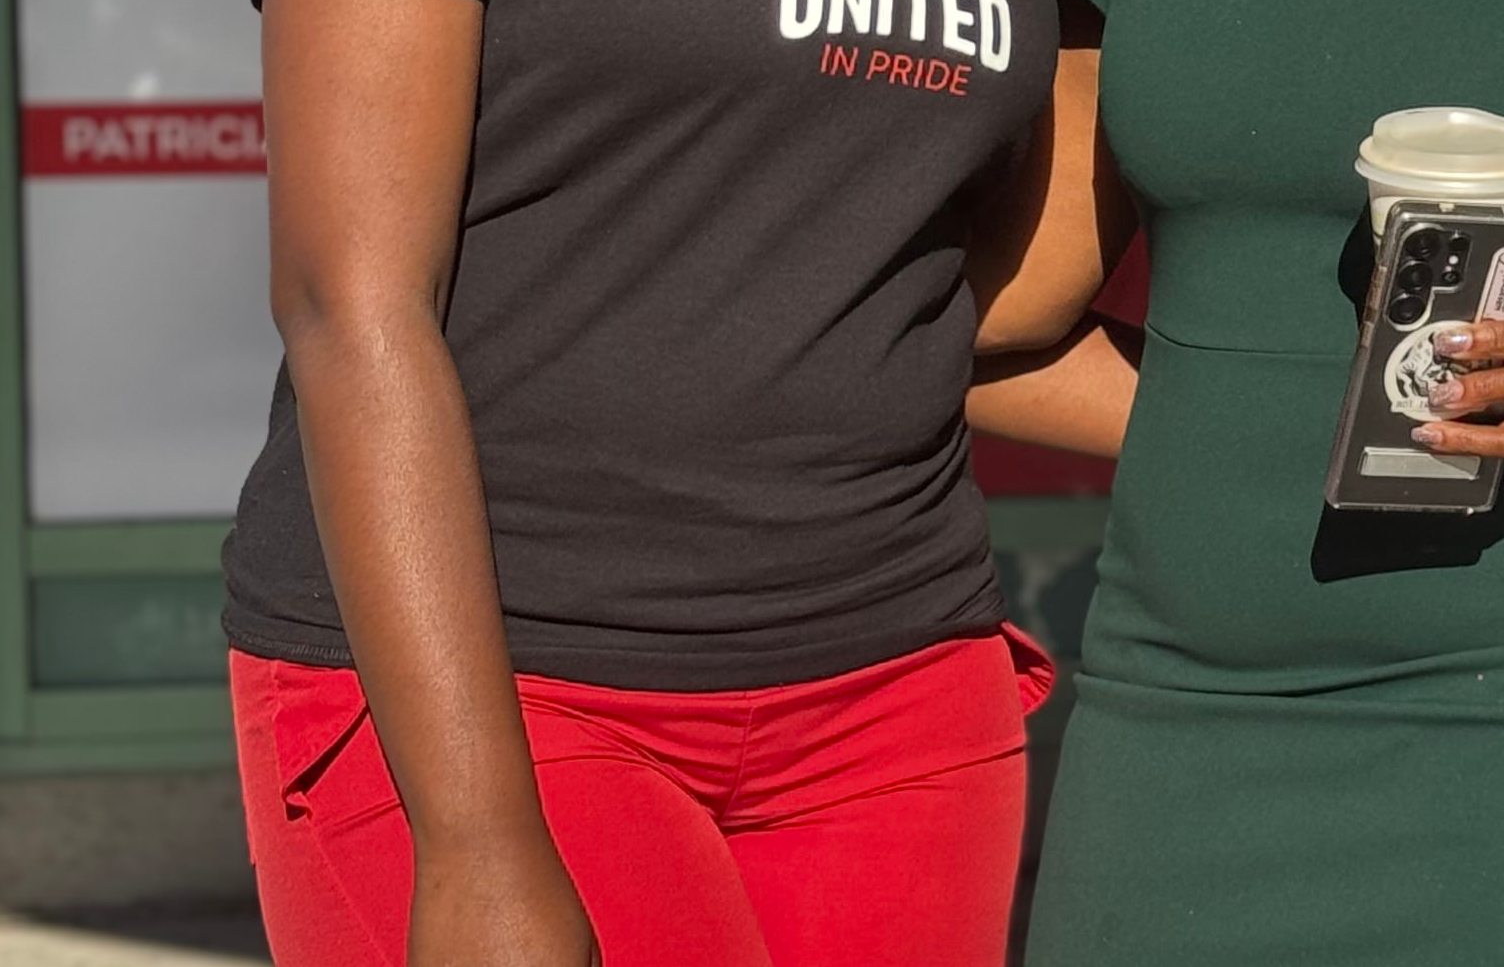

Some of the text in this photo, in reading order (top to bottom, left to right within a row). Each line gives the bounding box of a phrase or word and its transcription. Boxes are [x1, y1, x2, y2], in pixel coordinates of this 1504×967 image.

[820, 43, 972, 96] IN PRIDE
[62, 113, 266, 164] PATRICI
